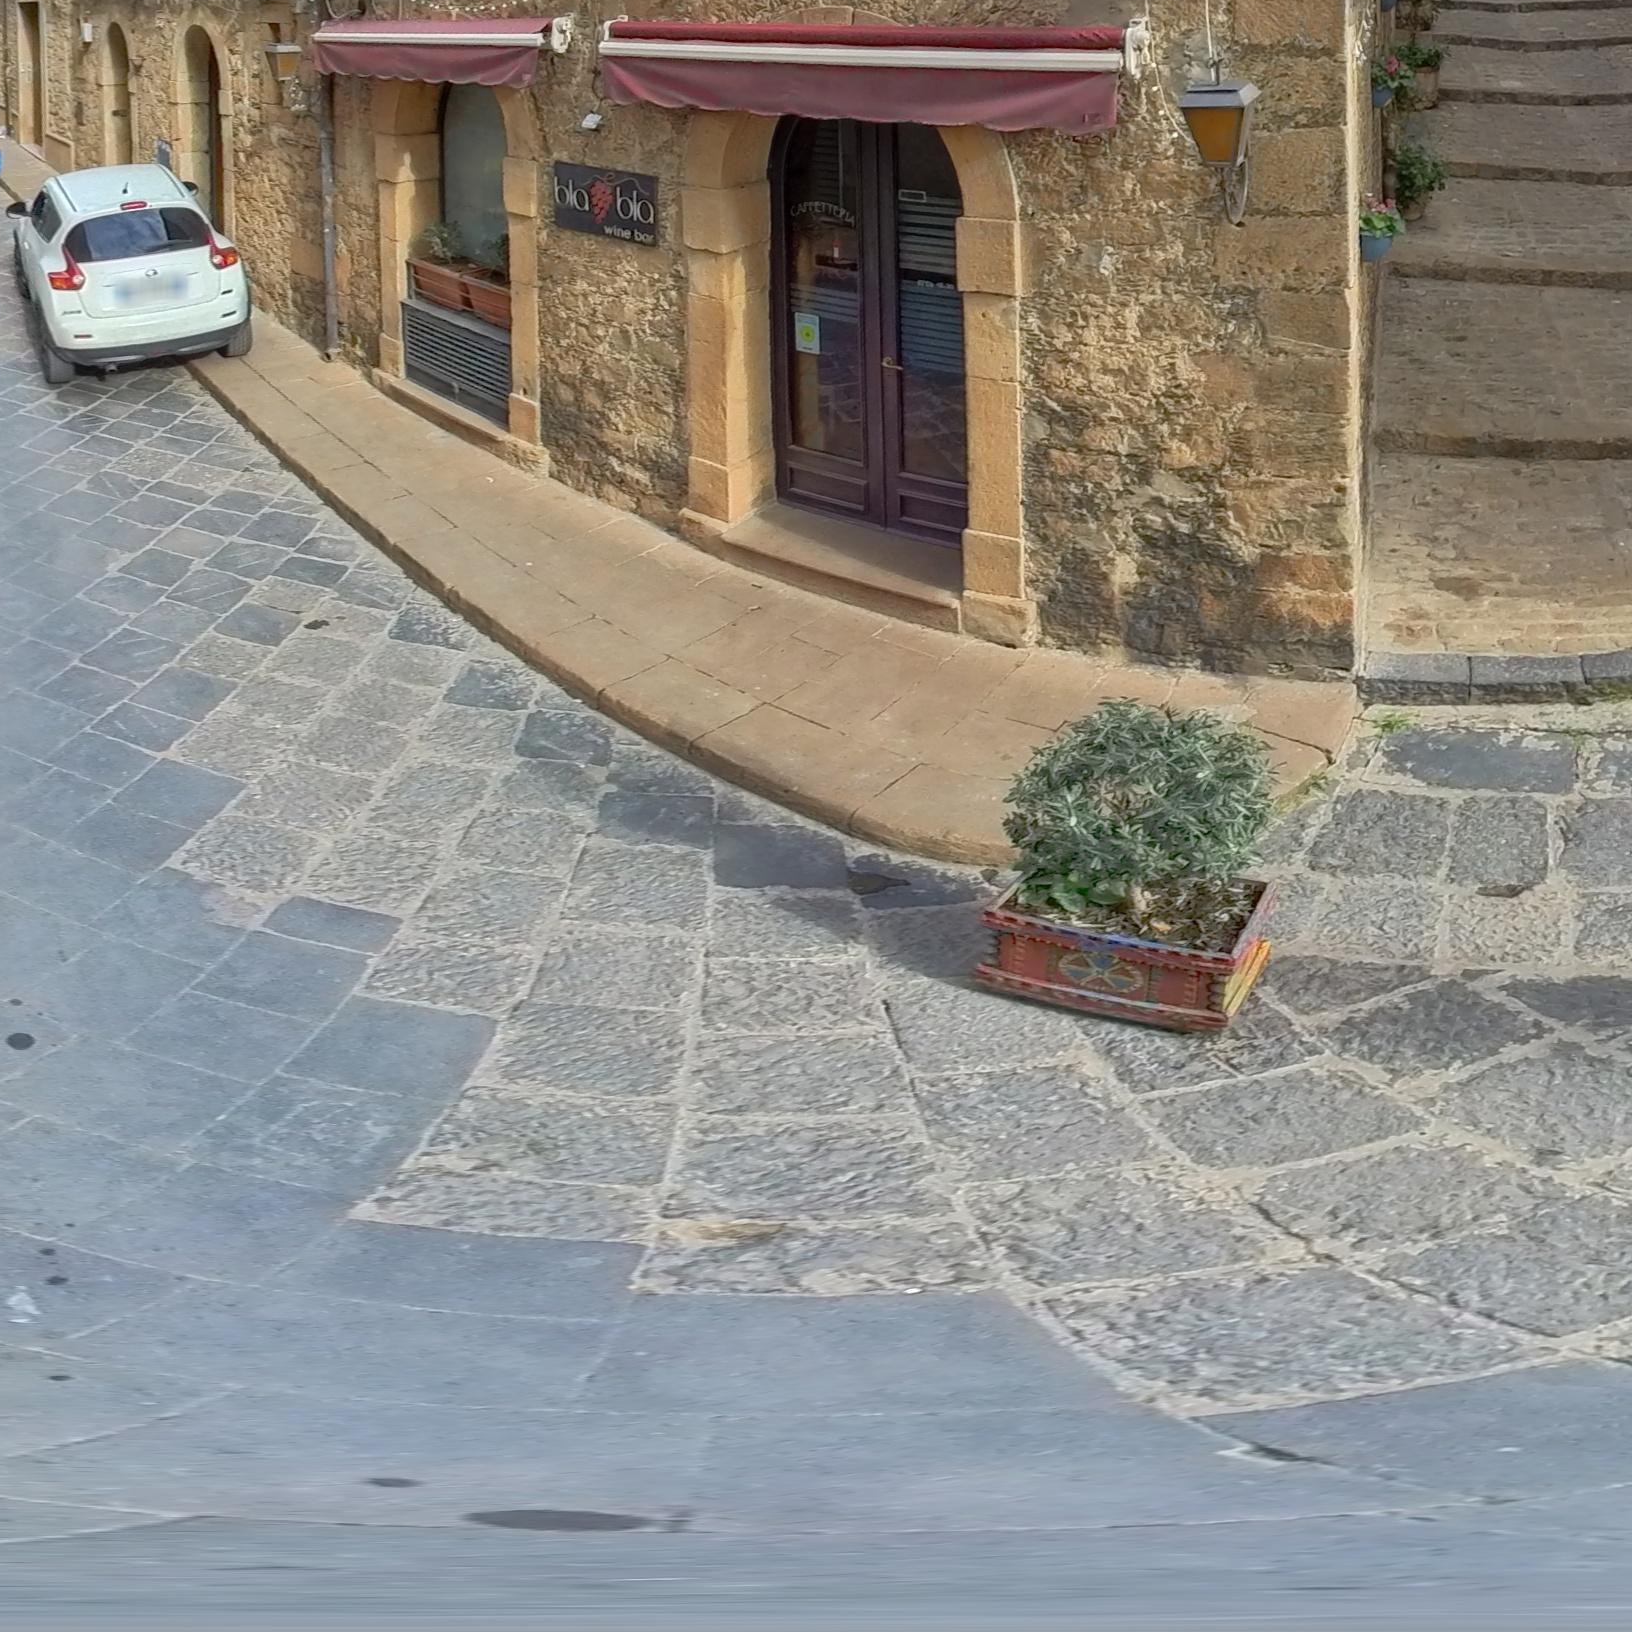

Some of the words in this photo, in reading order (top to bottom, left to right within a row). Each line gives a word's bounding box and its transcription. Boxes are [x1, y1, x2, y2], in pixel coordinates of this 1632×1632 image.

[554, 176, 589, 211] bla
[616, 186, 654, 224] bla
[790, 201, 855, 228] CAFFETTERIA
[604, 225, 631, 239] wine
[634, 229, 654, 243] bar
